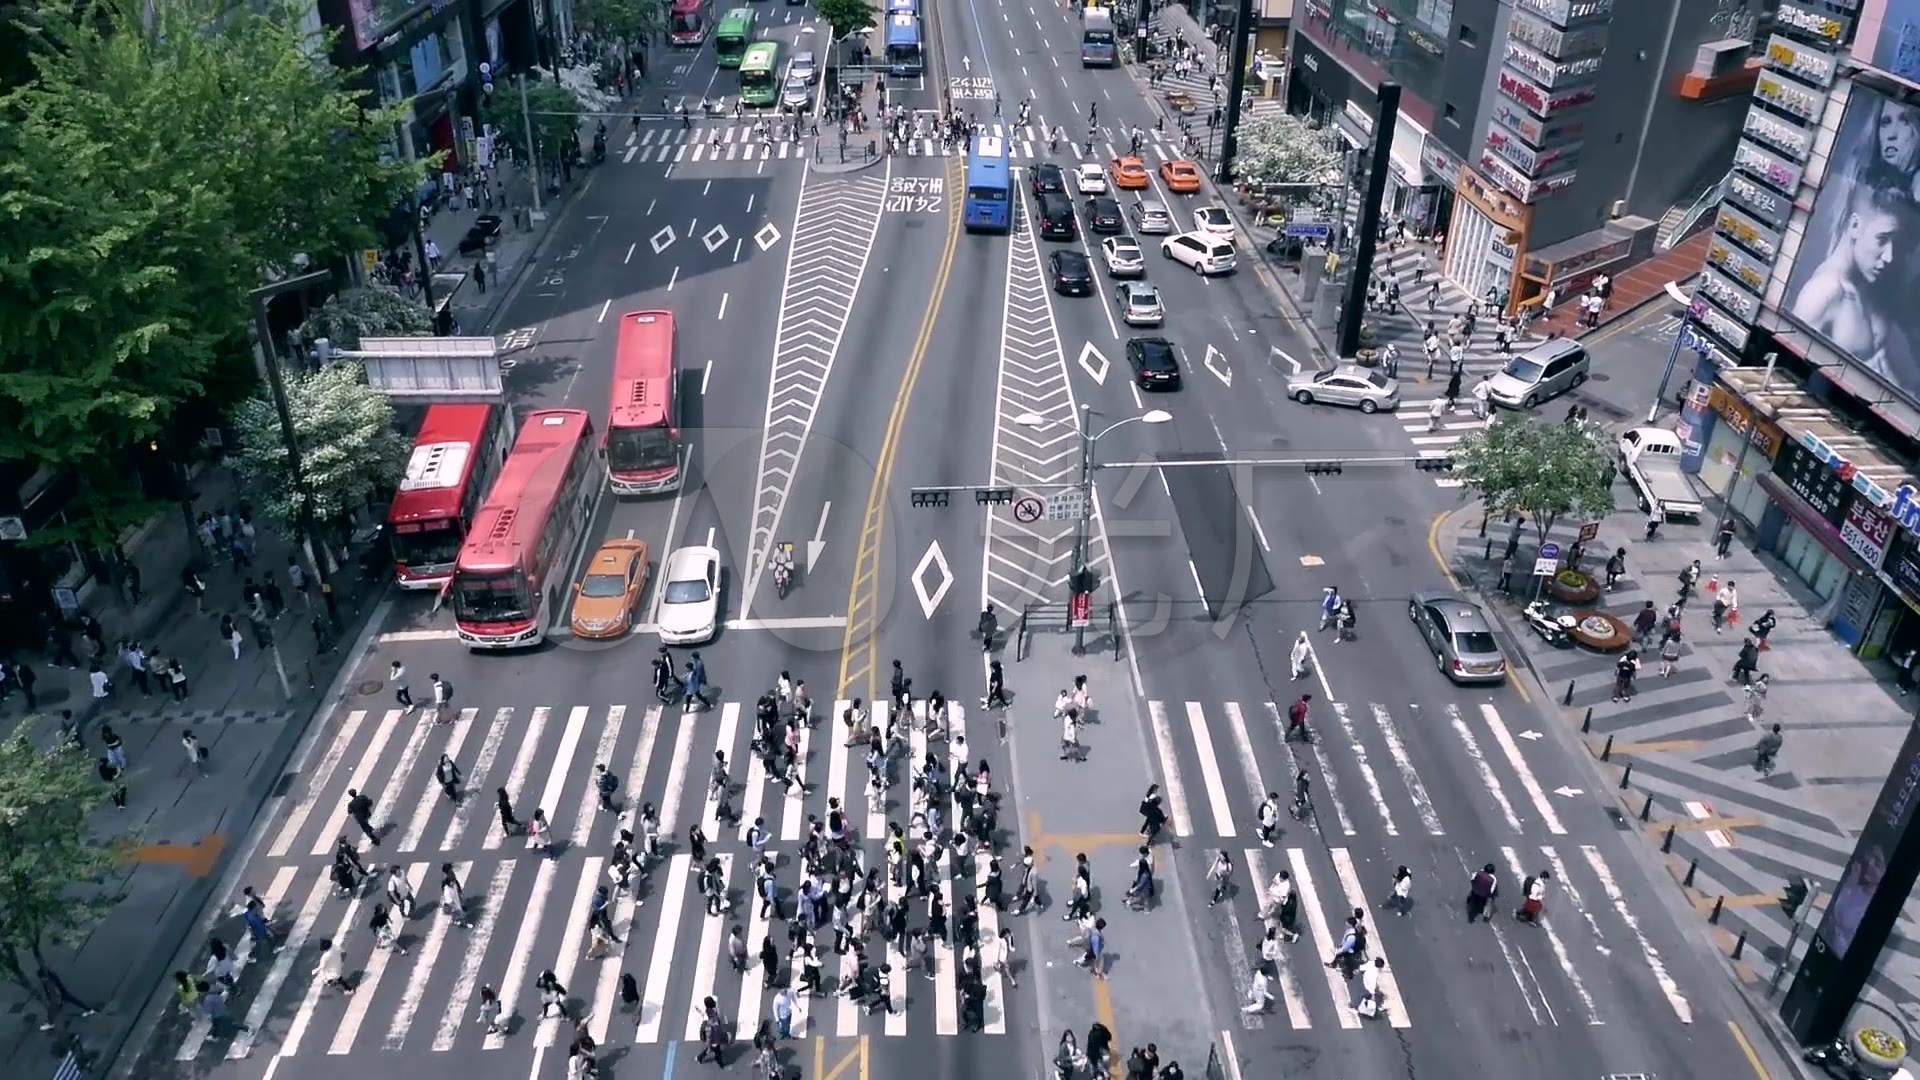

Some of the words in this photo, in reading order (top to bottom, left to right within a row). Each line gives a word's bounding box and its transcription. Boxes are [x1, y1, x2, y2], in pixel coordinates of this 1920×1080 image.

[890, 176, 944, 194] 버스전용
[885, 195, 942, 213] 24시간
[1850, 500, 1889, 543] 부동산
[1843, 523, 1879, 565] 561-1400
